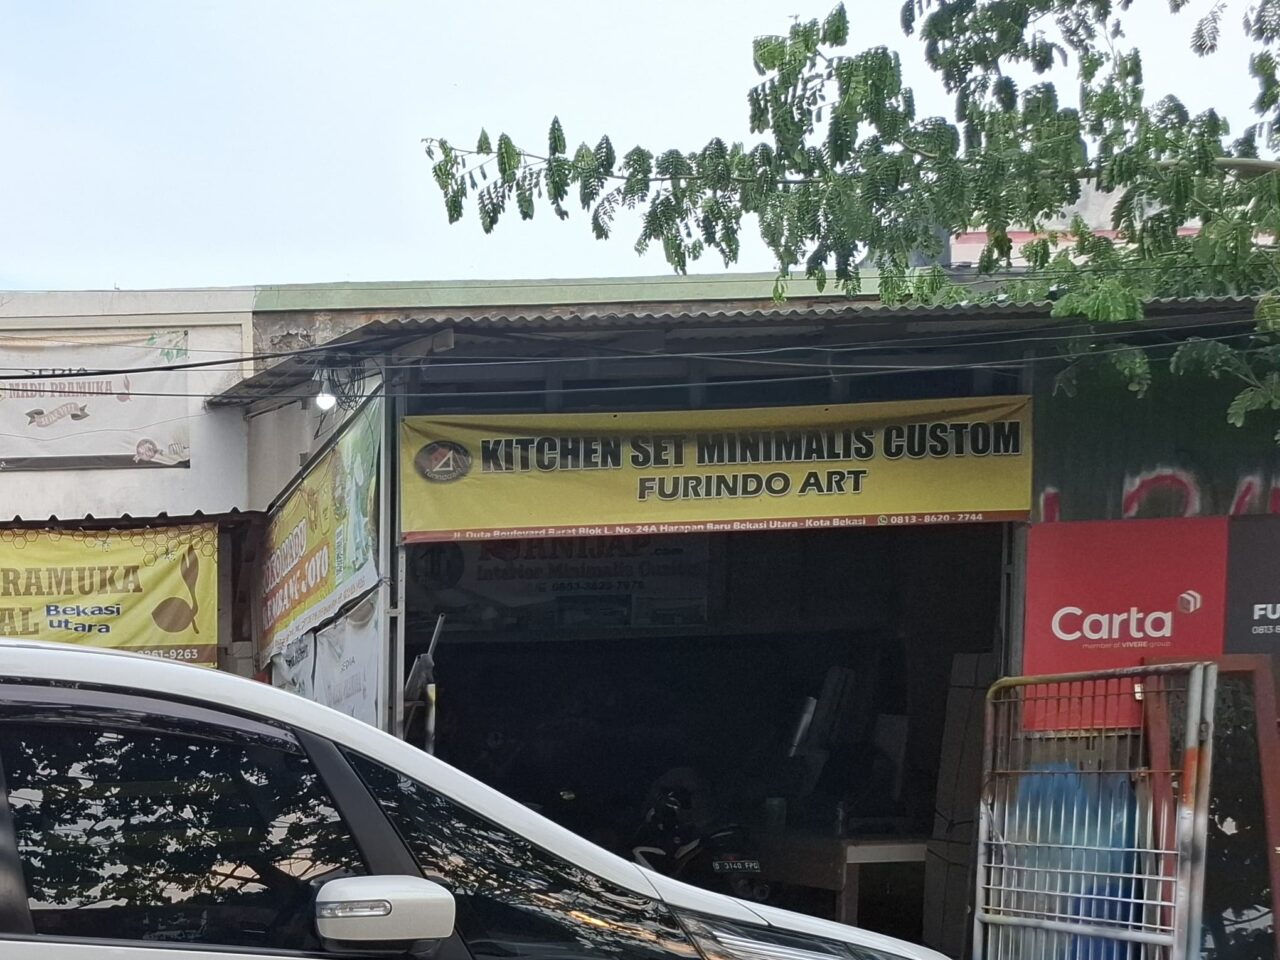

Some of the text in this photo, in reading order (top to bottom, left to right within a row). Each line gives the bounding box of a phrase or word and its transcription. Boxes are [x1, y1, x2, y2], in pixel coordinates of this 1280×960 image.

[479, 419, 1024, 474] KITCHEN SET MINIMALIS CUSTOM
[636, 468, 868, 502] FURINDO ART
[578, 526, 602, 535] Blok
[615, 525, 634, 534] No.
[636, 524, 657, 533] 24A
[659, 523, 705, 533] Harapan
[706, 522, 731, 531] Baru
[733, 521, 767, 530] Bekasi
[768, 520, 798, 529] Utara
[805, 518, 831, 528] Kota
[832, 517, 867, 527] Bekasi
[890, 515, 917, 524] 0813
[923, 514, 950, 523] 8620
[957, 513, 983, 521] 2744
[45, 603, 122, 617] Bekasi
[48, 618, 111, 634] utara
[1051, 606, 1173, 641] Carta
